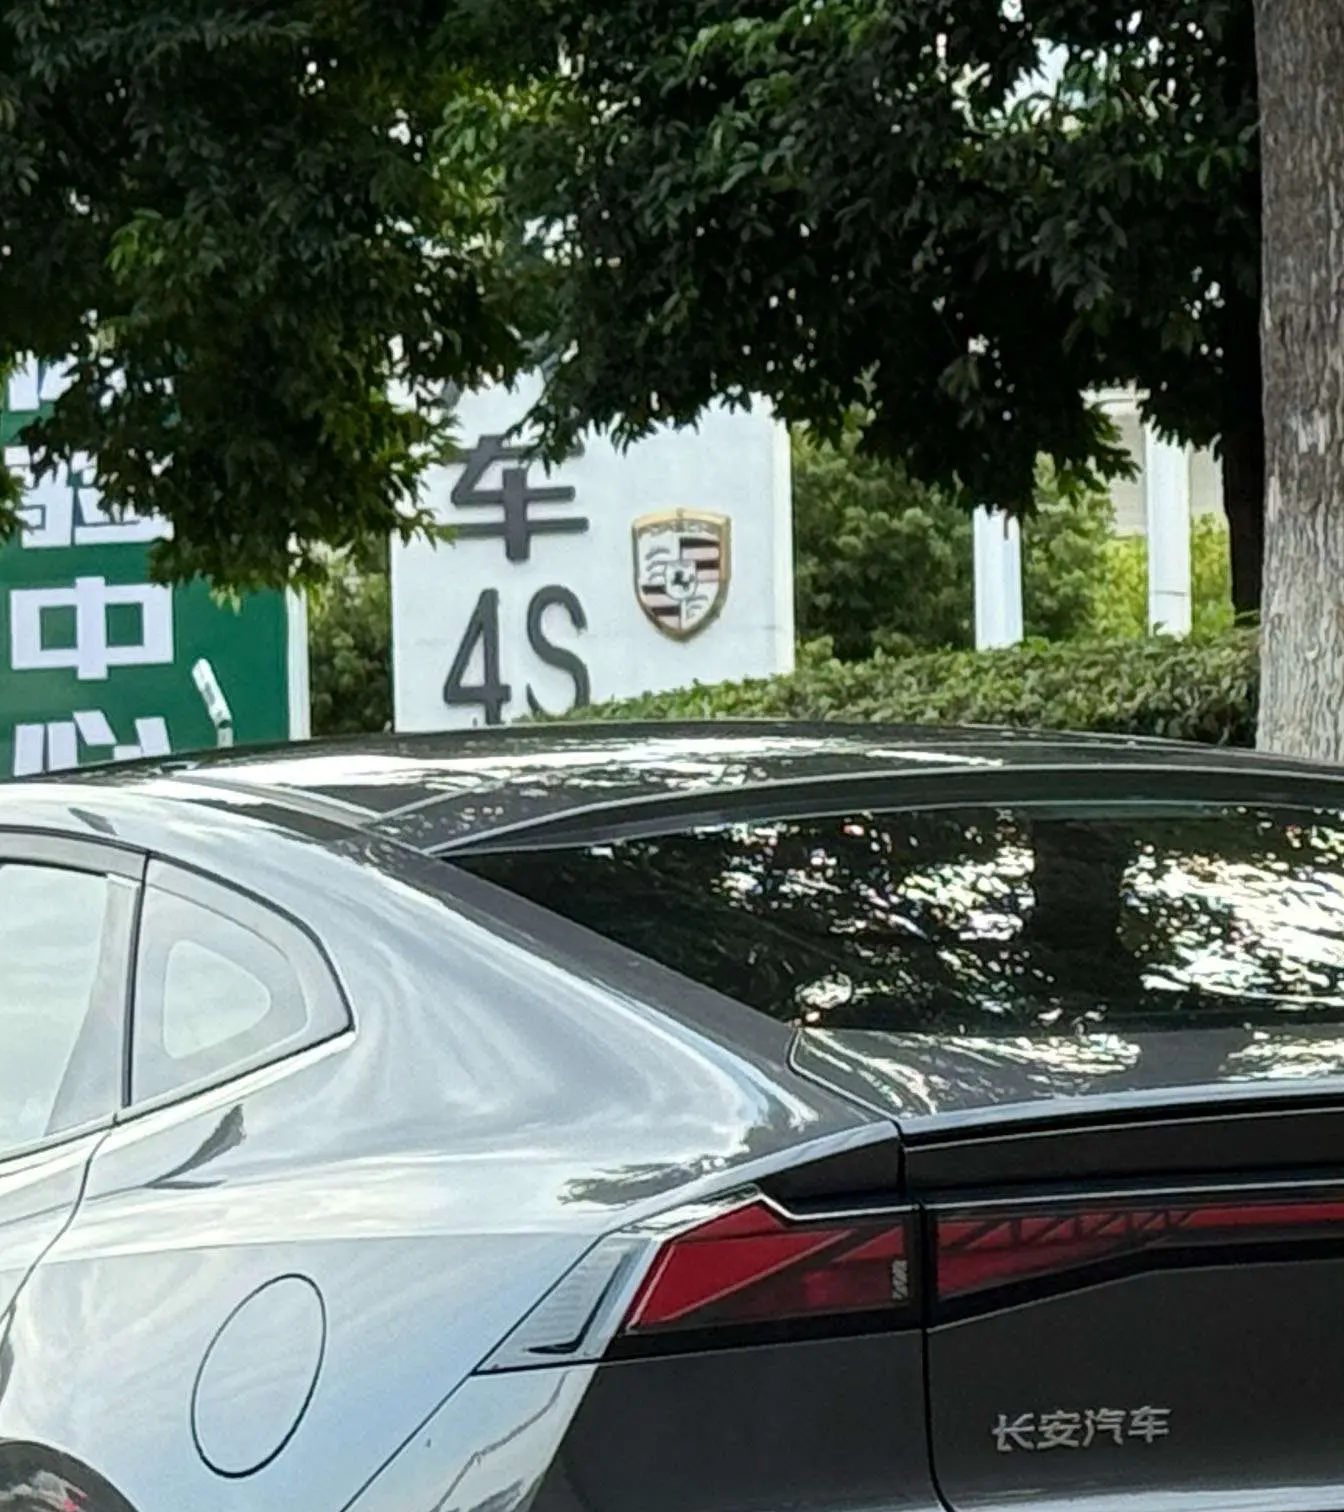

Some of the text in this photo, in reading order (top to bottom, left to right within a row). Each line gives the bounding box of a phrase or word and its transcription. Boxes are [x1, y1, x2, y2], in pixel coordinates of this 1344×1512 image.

[443, 584, 591, 726] 4S
[992, 1405, 1172, 1451] 长安汽车
